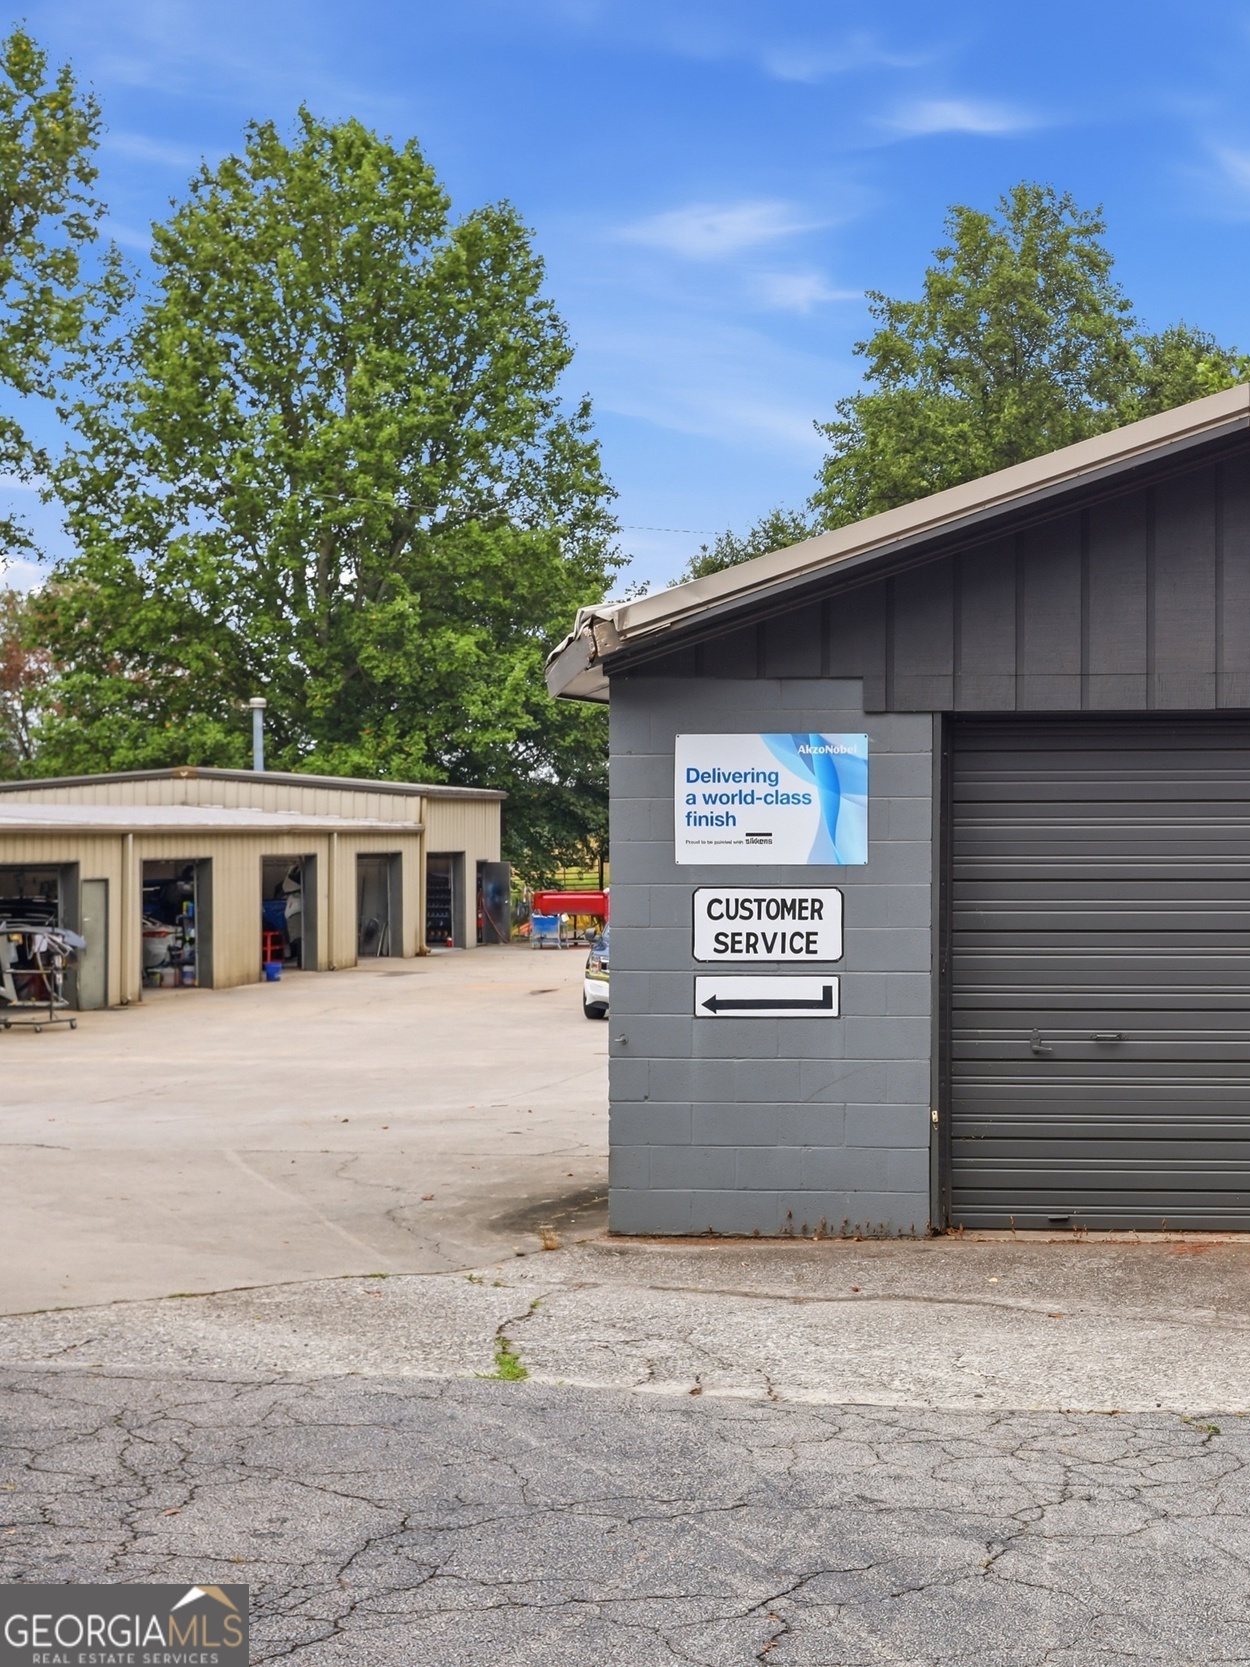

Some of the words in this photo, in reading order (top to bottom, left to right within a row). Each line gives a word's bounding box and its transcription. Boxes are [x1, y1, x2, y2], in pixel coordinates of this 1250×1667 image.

[798, 744, 857, 754] AkzoNobel
[685, 767, 779, 787] Delivering
[685, 793, 697, 805] a
[702, 789, 812, 805] world-class
[685, 811, 737, 827] finish
[706, 897, 824, 921] CUSTOMER
[713, 931, 819, 955] SERVICE
